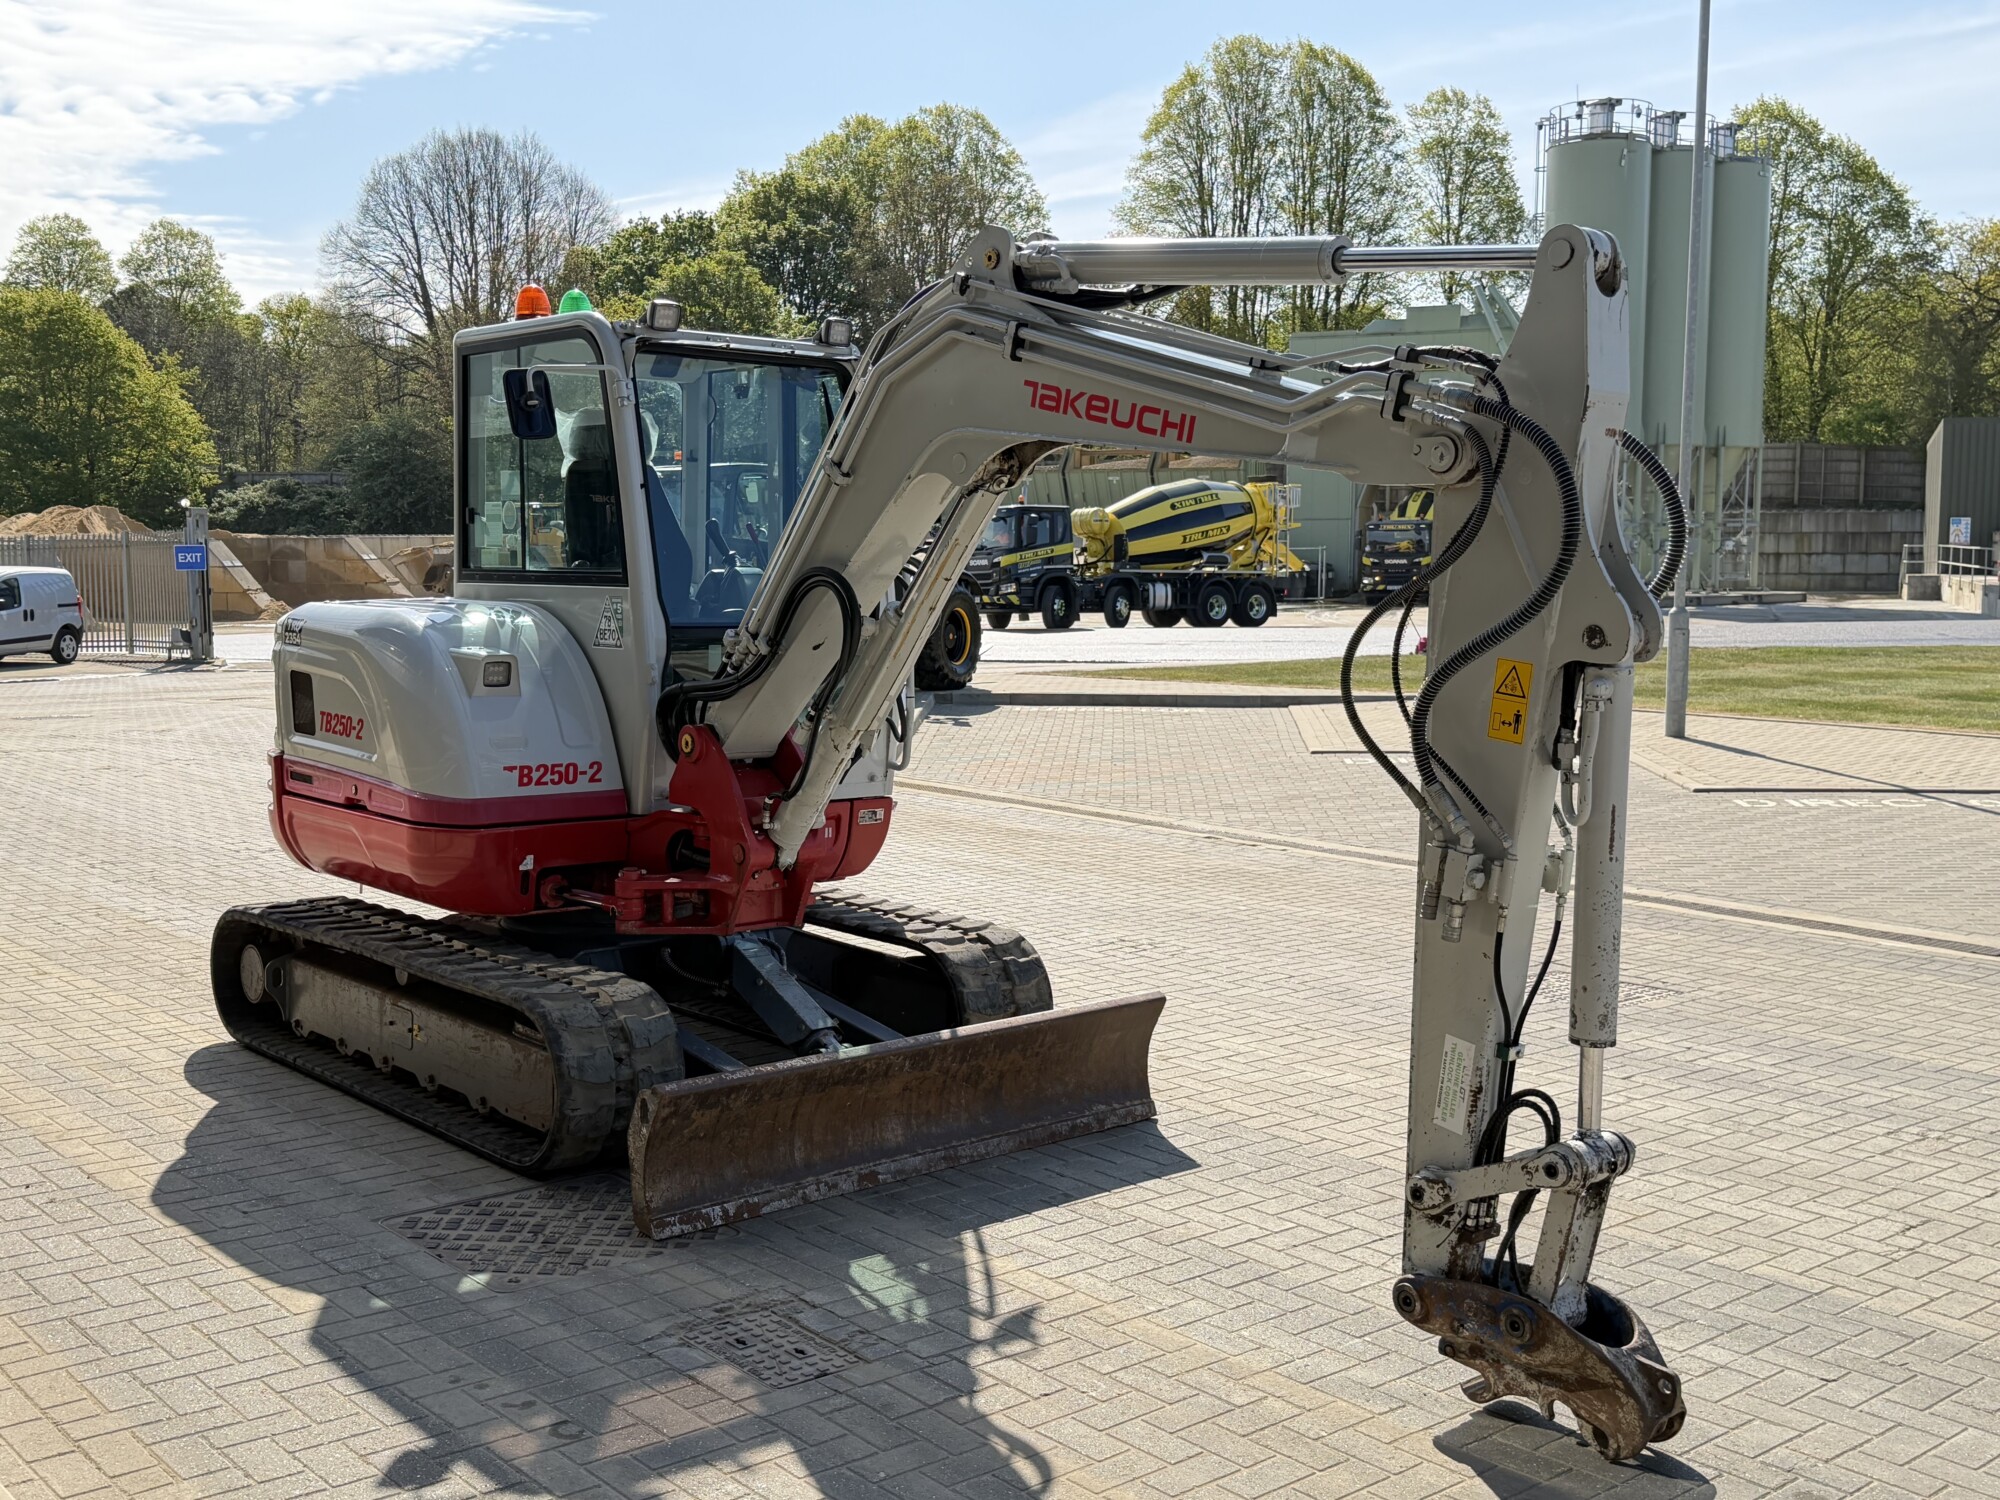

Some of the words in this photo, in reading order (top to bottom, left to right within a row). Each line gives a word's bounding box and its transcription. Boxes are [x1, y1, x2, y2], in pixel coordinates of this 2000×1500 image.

[178, 553, 202, 563] EXIT
[320, 711, 364, 740] TB250-2
[1445, 1042, 1457, 1085] TWINLOCK
[1453, 1052, 1463, 1087] GENUINE
[1441, 1085, 1451, 1122] COUPLER
[1449, 1088, 1458, 1119] MILLER
